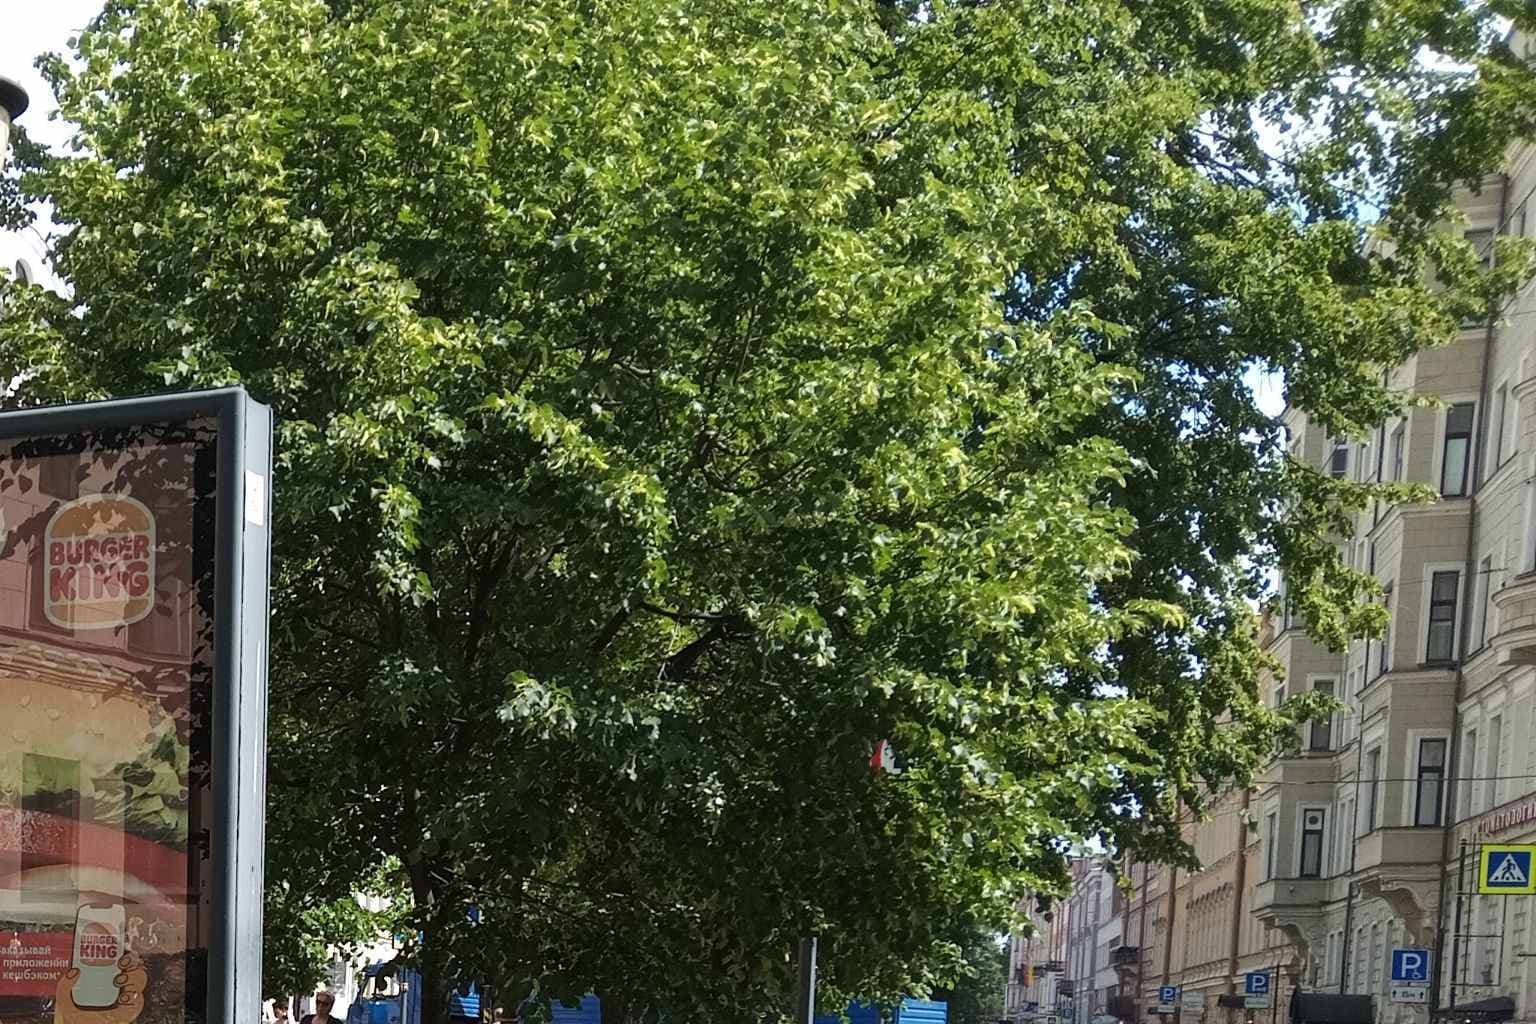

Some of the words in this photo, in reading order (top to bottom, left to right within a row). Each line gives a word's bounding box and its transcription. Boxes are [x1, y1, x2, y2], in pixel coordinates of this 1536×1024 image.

[49, 534, 150, 566] BURGER
[49, 561, 150, 602] KING
[80, 935, 117, 944] BURGER
[80, 945, 117, 959] KING
[2, 959, 69, 970] приложении
[1402, 953, 1421, 978] P
